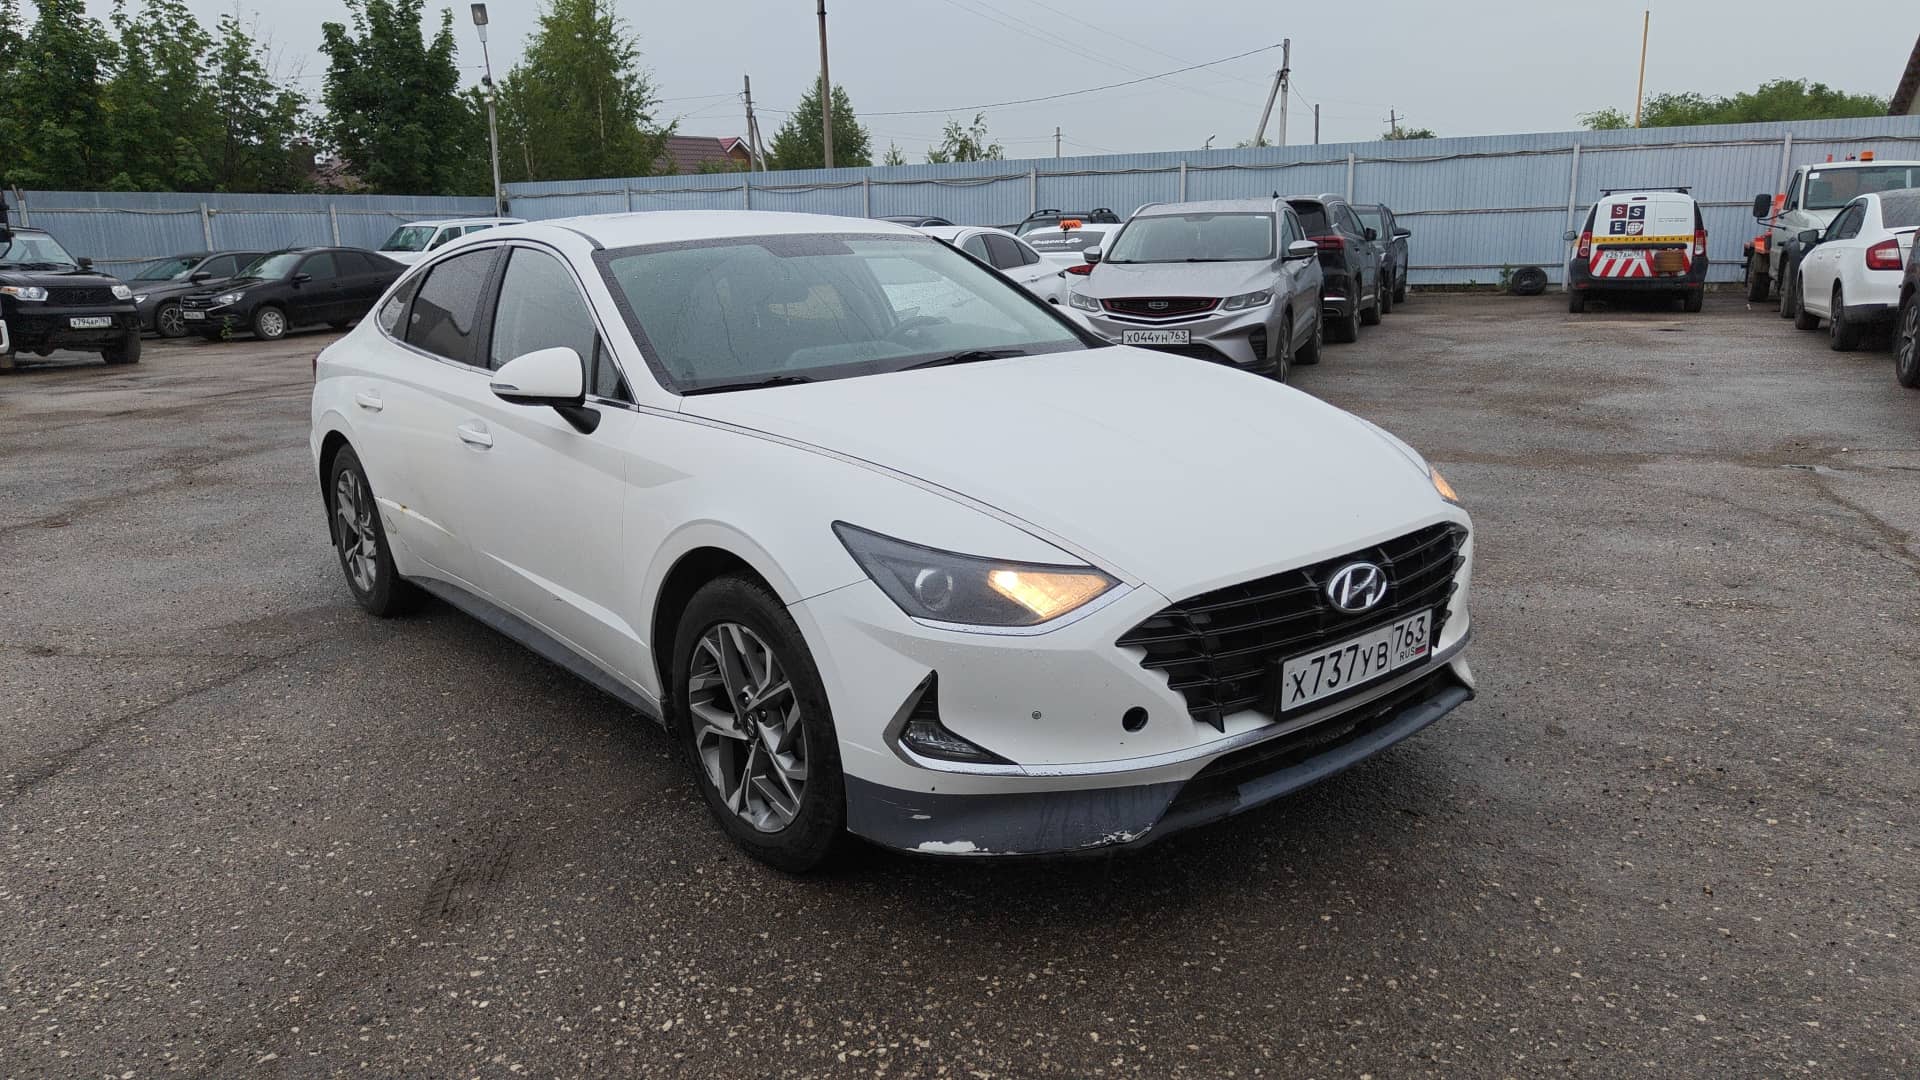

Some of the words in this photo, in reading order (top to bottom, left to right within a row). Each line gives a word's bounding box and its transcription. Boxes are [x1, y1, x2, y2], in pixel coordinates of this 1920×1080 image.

[1614, 222, 1622, 231] E
[1126, 331, 1168, 343] Х044УН
[1169, 331, 1186, 340] 763
[1291, 642, 1389, 703] Х737УВ
[1394, 616, 1426, 653] 763
[1399, 646, 1415, 662] RUS
